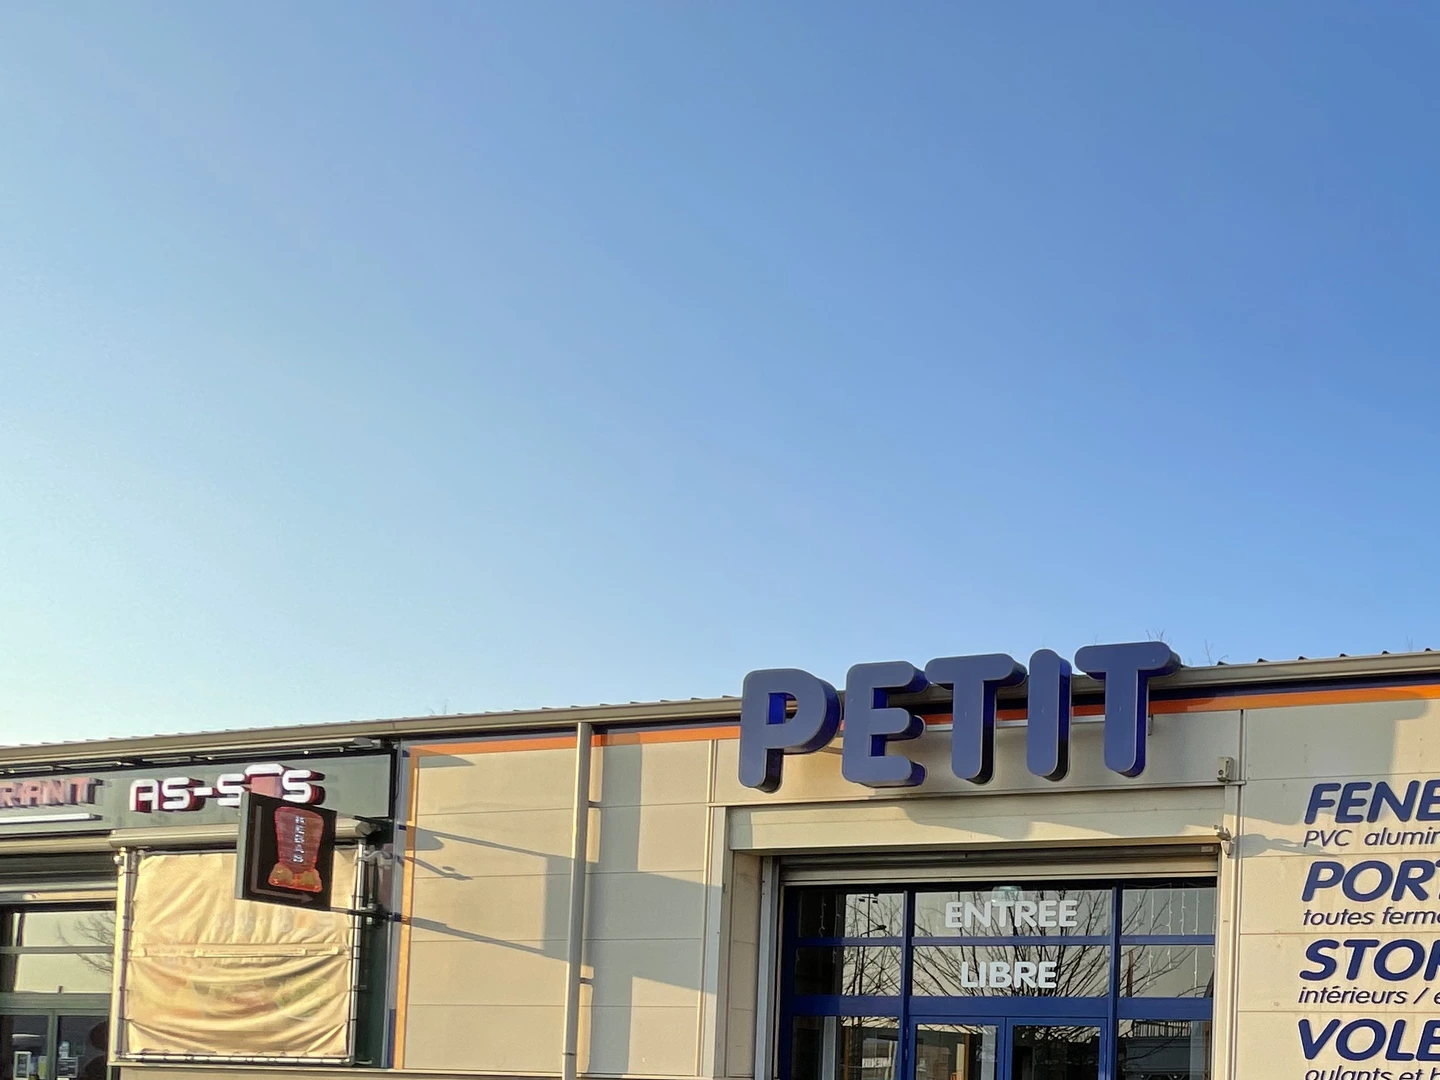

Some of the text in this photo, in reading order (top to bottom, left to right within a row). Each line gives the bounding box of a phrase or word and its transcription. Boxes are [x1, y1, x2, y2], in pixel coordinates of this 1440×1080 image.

[738, 640, 1181, 793] PETIT
[1303, 828, 1354, 848] PVC
[945, 899, 1078, 928] ENTREE
[1302, 907, 1375, 926] toutes
[960, 961, 1058, 989] LIBRE
[1298, 985, 1409, 1005] intérieurs
